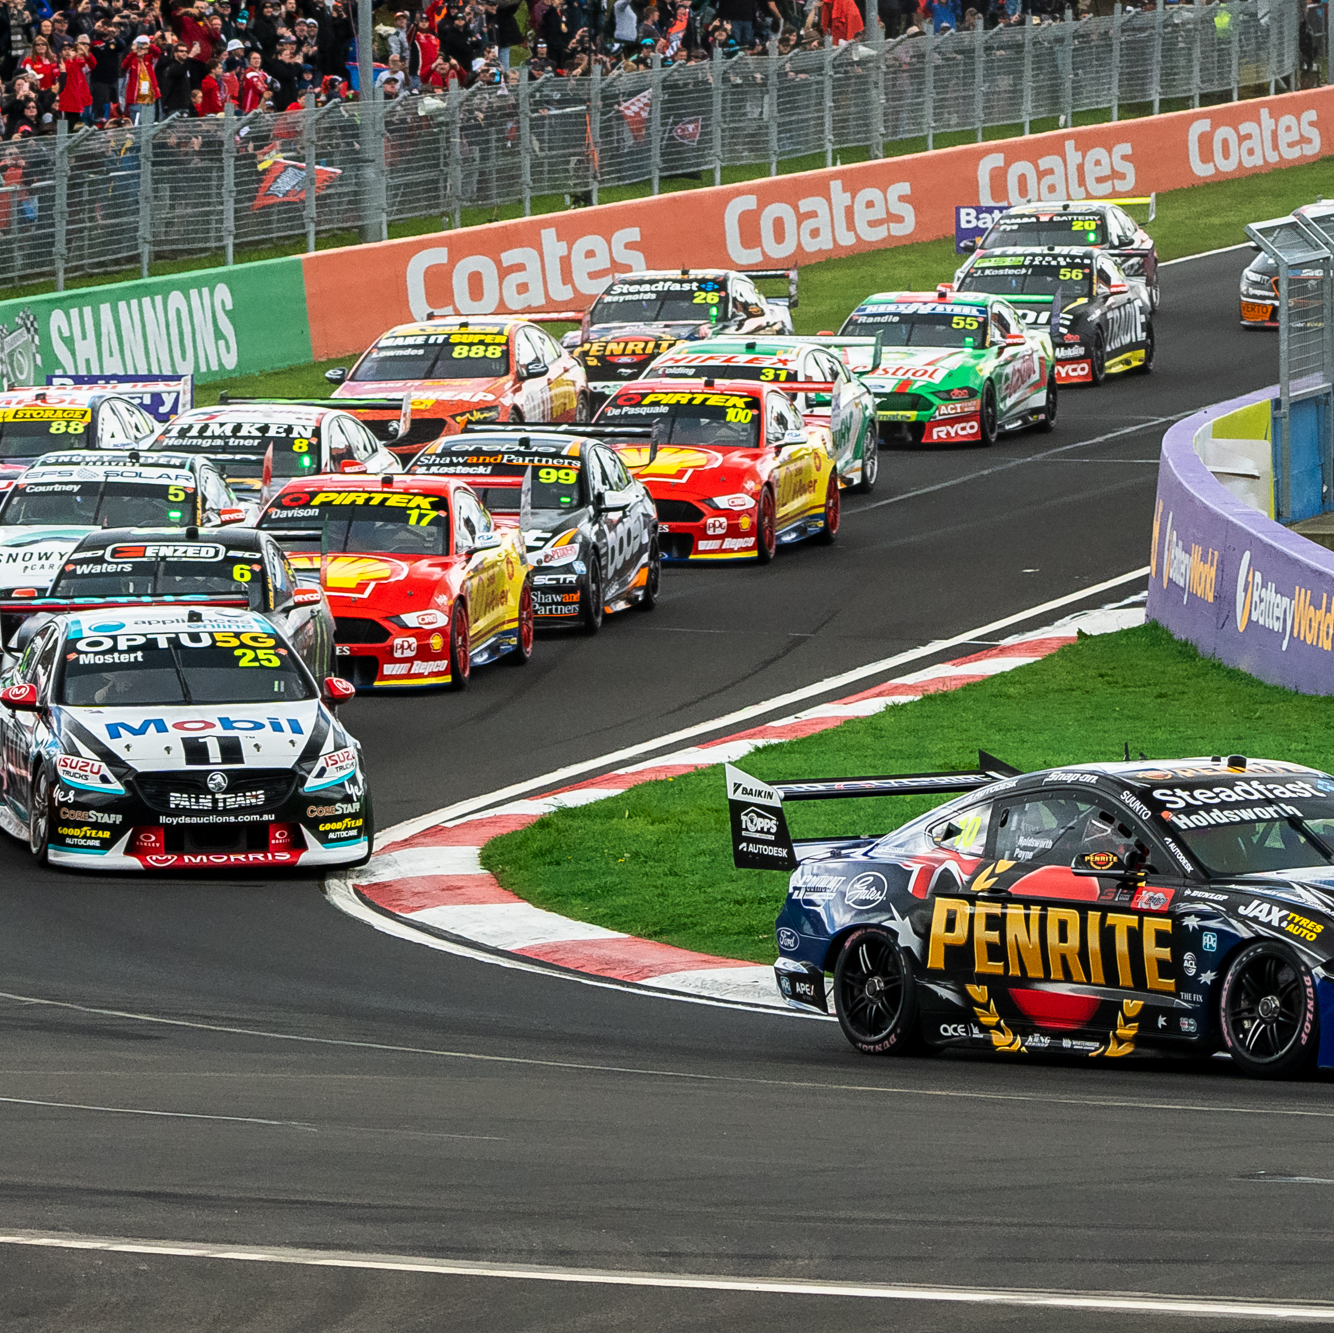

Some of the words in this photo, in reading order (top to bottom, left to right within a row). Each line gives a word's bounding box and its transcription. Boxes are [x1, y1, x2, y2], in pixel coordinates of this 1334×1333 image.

[1188, 108, 1322, 177] Coates
[978, 139, 1135, 203] Coates
[724, 179, 916, 266] Coates
[1071, 220, 1096, 231] 20
[406, 226, 648, 322] Coates
[1059, 268, 1084, 280] 56
[610, 281, 699, 294] Steadfast
[604, 292, 657, 303] Reynolds
[693, 292, 719, 304] 26
[857, 315, 900, 324] Randle
[951, 316, 979, 329] 55
[50, 282, 238, 376] SHANNONS
[378, 334, 426, 347] MAKE
[428, 333, 447, 345] IT
[449, 334, 508, 344] SUPER
[372, 347, 424, 358] Lowndes
[451, 345, 503, 359] 888
[661, 355, 797, 367] HIFLEX
[760, 369, 788, 381] 31
[641, 394, 753, 407] PIRTEK
[16, 409, 89, 419] STORAGE
[726, 407, 753, 423] 100
[940, 403, 962, 414] ACT
[49, 421, 86, 434] 88
[166, 422, 316, 438] TIMKEN
[933, 421, 979, 440] RYCO
[293, 439, 309, 453] 8
[417, 453, 581, 467] ShawandPartners
[25, 468, 74, 479] EFS
[104, 469, 193, 482] SOLAR
[538, 468, 577, 484] 99
[25, 483, 81, 493] Courtney
[168, 485, 185, 502] 5
[310, 492, 439, 509] PIRTEK
[271, 507, 319, 520] Davison
[406, 508, 439, 527] 17
[708, 519, 727, 534] PPG
[722, 536, 755, 550] Repco
[144, 545, 219, 558] ENZED
[75, 562, 133, 574] Waters
[233, 564, 251, 582] 6
[532, 574, 578, 585] SCTR
[294, 591, 321, 604] RYCO
[532, 602, 580, 615] Partners
[1251, 570, 1295, 652] Battery
[418, 613, 438, 625] CRG
[395, 638, 417, 657] PPG
[79, 651, 144, 664] Mostert
[234, 648, 281, 667] 25
[411, 659, 448, 676] Repco
[104, 716, 305, 740] Mobil
[199, 736, 224, 764] 1
[57, 756, 102, 775] ISUZU
[324, 751, 355, 768] ISUZU
[62, 770, 90, 781] TRUCKS
[53, 784, 75, 804] yes
[741, 785, 774, 802] BAIKIN
[1153, 779, 1328, 810] Steadfast
[307, 802, 360, 817] CORESTAFF
[1120, 790, 1152, 820] SUUNTO
[59, 807, 123, 824] CORESTAFF
[159, 814, 275, 824] lloydsauctions.com.au
[741, 812, 777, 833] TOPPS
[1172, 801, 1303, 831] Holdsworth
[328, 830, 358, 839] AUTOCARE
[953, 815, 982, 848] 10
[66, 838, 101, 846] AUTOCARE
[1018, 835, 1053, 849] Holdsworth
[748, 842, 788, 858] AUTODESK
[183, 852, 291, 864] MORRIS
[1085, 854, 1118, 864] PENRITE
[1170, 842, 1194, 873] AUTODESK
[1191, 890, 1229, 902] DUNLOP
[1238, 899, 1290, 927] JAX
[1286, 912, 1324, 934] TYRES
[779, 930, 798, 947] Ford
[1285, 922, 1317, 942] AUTO
[927, 897, 1176, 993] PENRITE
[1183, 961, 1197, 969] ACL
[1180, 992, 1192, 1001] THE
[1193, 993, 1204, 1003] FIX
[1301, 976, 1315, 1046] DUNLOP
